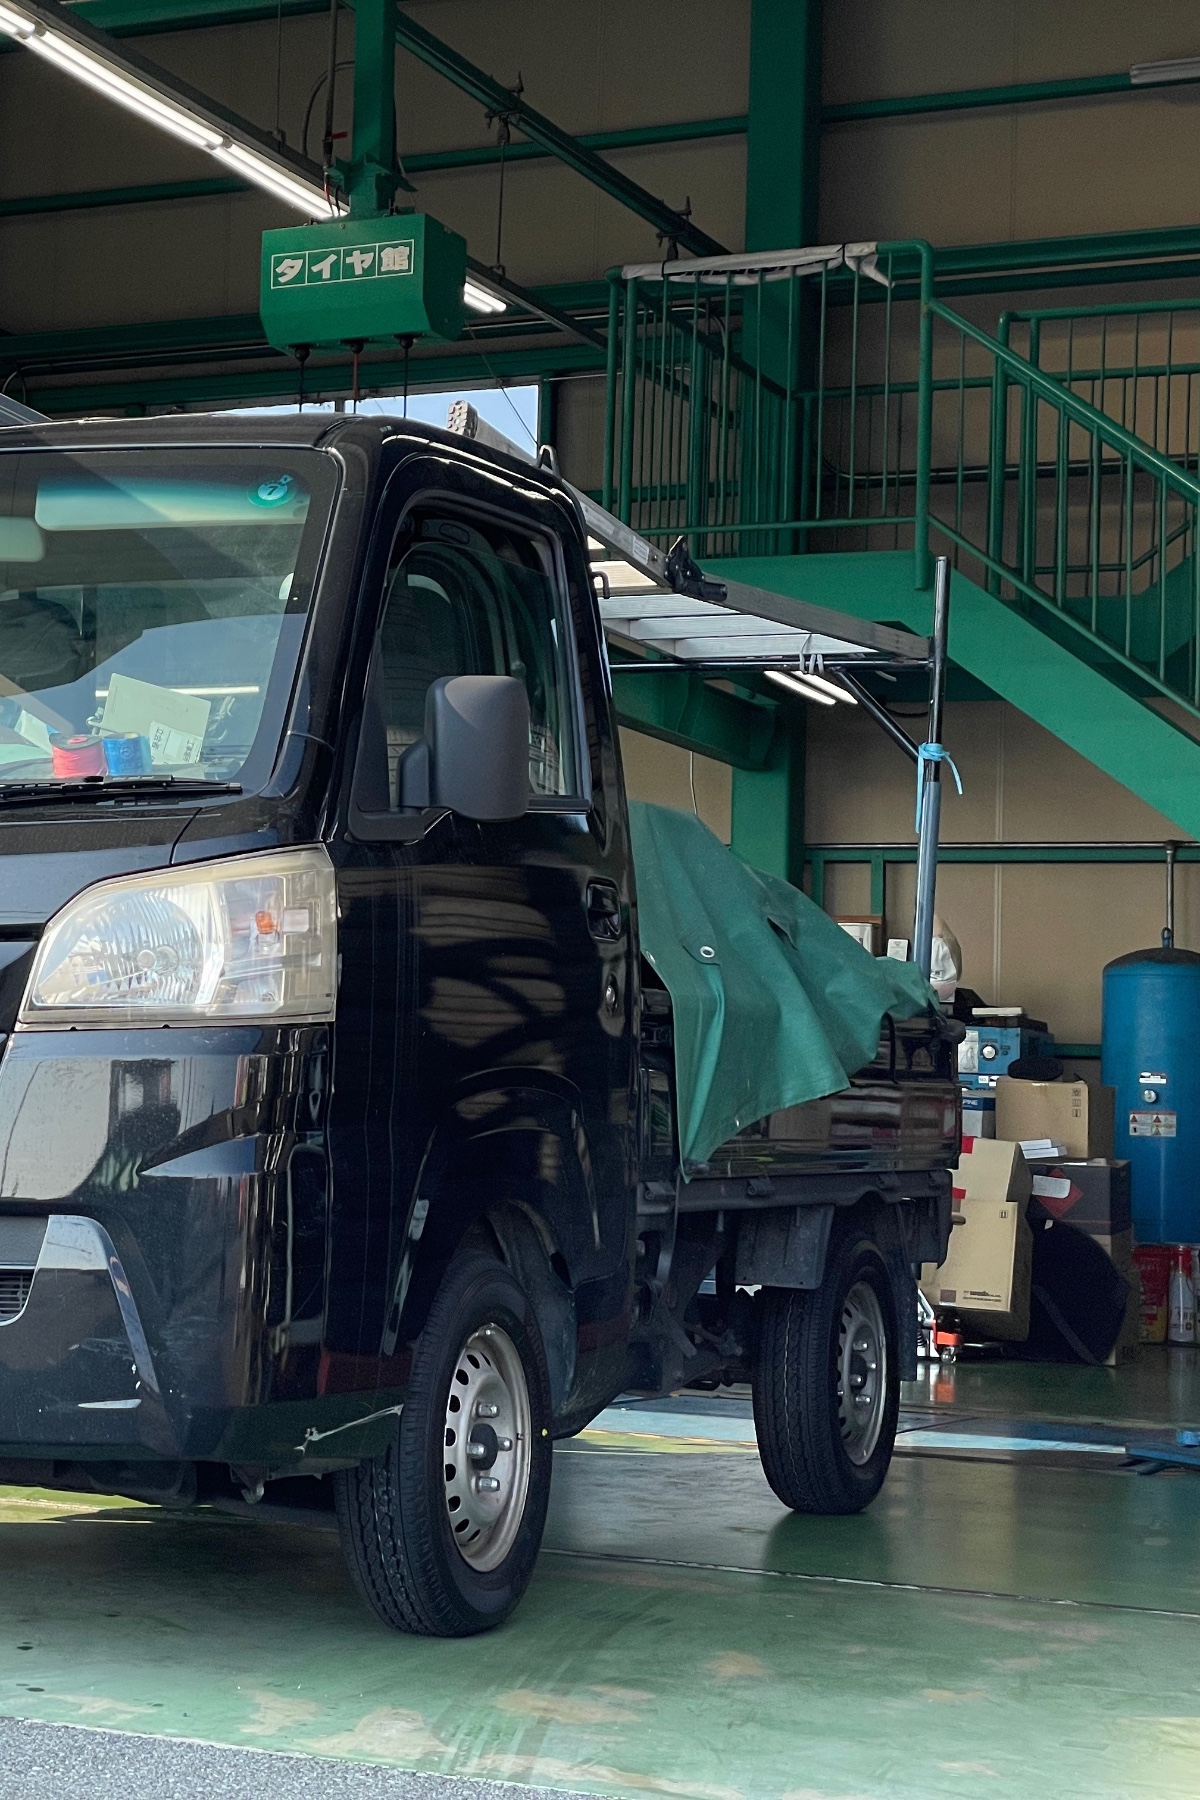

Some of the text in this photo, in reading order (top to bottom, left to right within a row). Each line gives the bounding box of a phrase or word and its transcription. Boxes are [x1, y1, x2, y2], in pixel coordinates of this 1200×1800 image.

[275, 245, 410, 283] タイヤ館
[267, 485, 279, 496] 7
